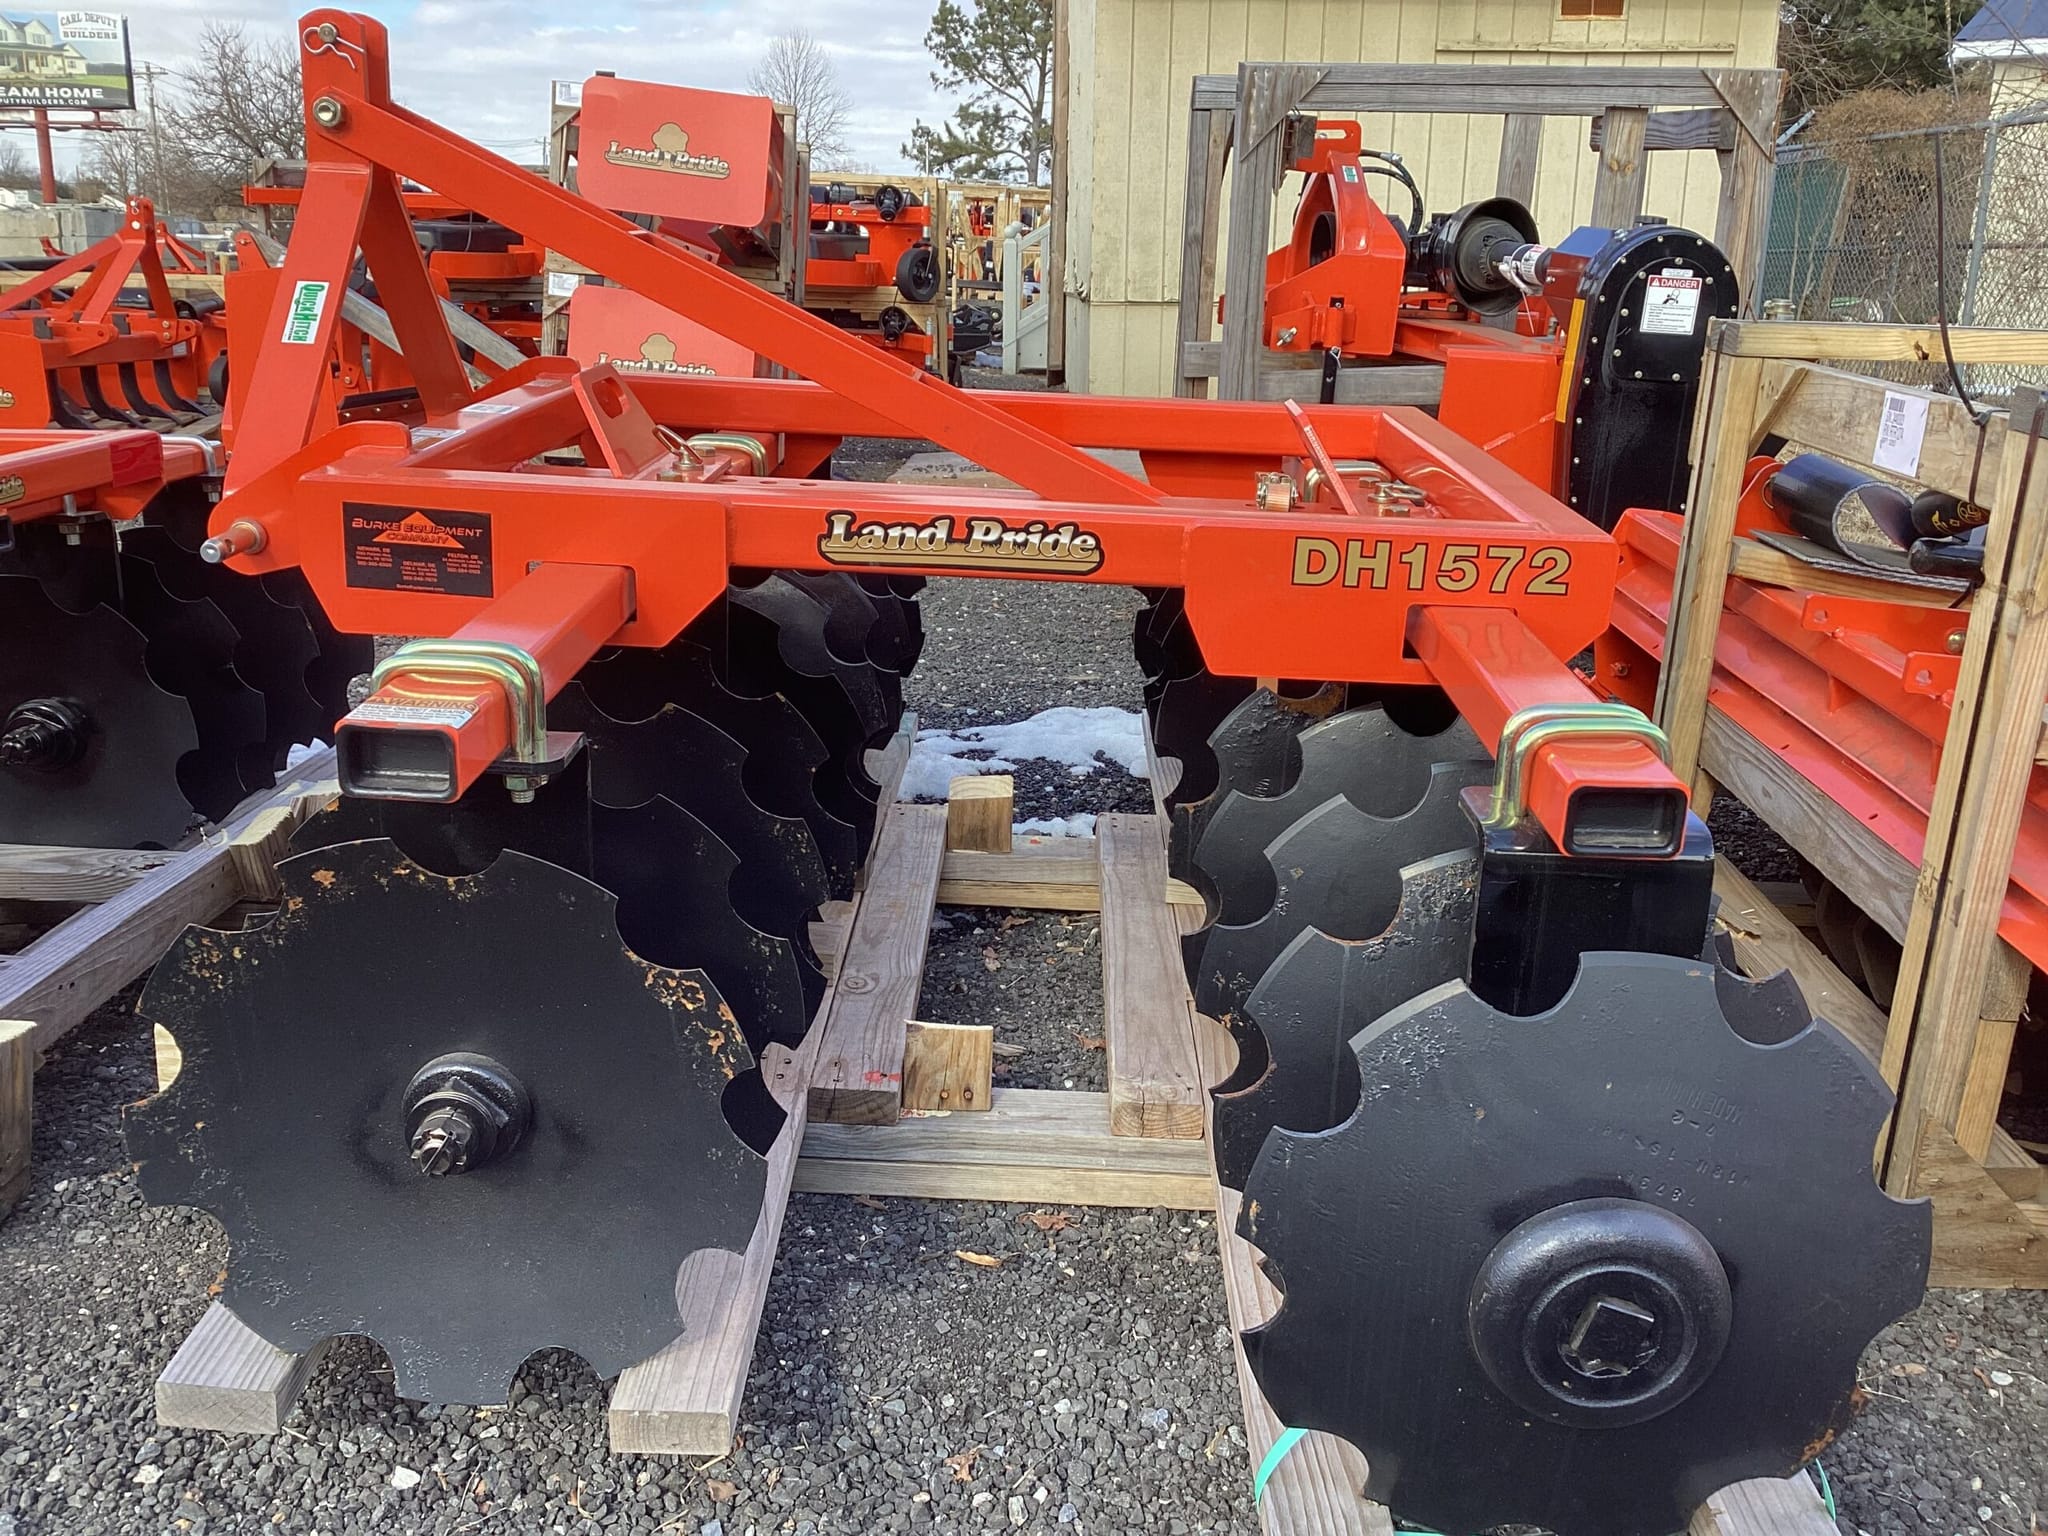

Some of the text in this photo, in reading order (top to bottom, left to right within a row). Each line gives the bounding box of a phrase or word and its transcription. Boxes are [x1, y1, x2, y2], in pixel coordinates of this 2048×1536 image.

[60, 12, 118, 29] CARL DEPUTY
[63, 31, 118, 39] BUILDERS
[45, 88, 104, 98] HOME
[607, 142, 729, 173] Land Pride
[1661, 279, 1698, 289] DANGER
[352, 518, 483, 537] BURKE EQUIPMENT
[387, 532, 450, 544] COMPANY
[826, 514, 1097, 558] Land Pride
[1291, 536, 1572, 596] DH1572
[390, 696, 477, 711] WARNING
